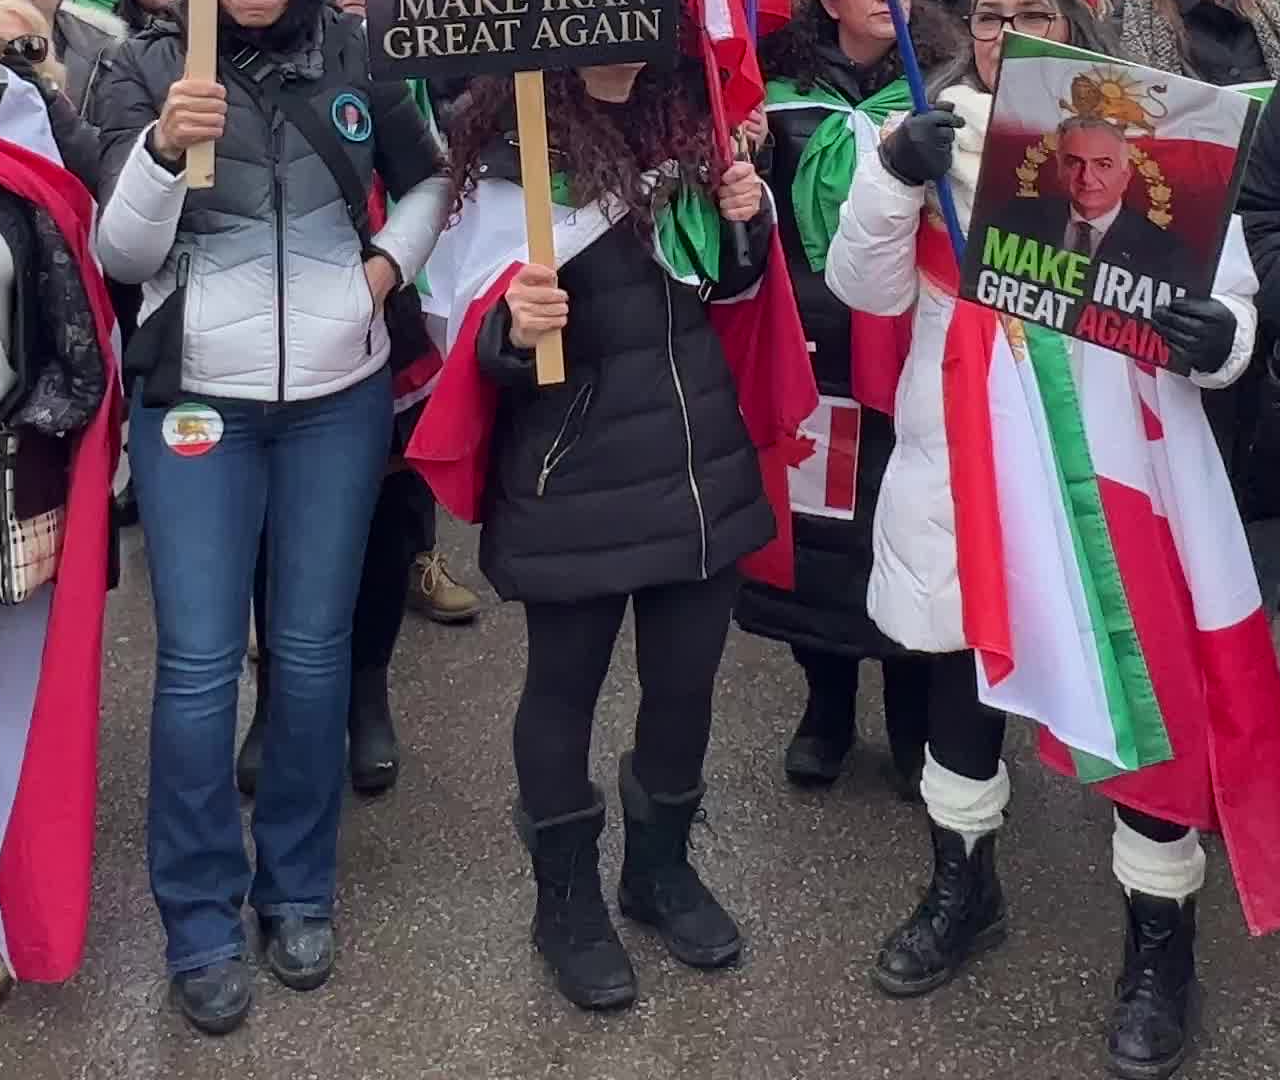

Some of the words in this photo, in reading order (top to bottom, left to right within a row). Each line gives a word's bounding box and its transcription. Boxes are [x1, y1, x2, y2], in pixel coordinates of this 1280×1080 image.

[383, 19, 521, 59] GREAT
[531, 8, 663, 49] AGAIN
[981, 225, 1091, 297] MAKE
[976, 269, 1075, 329] GREAT
